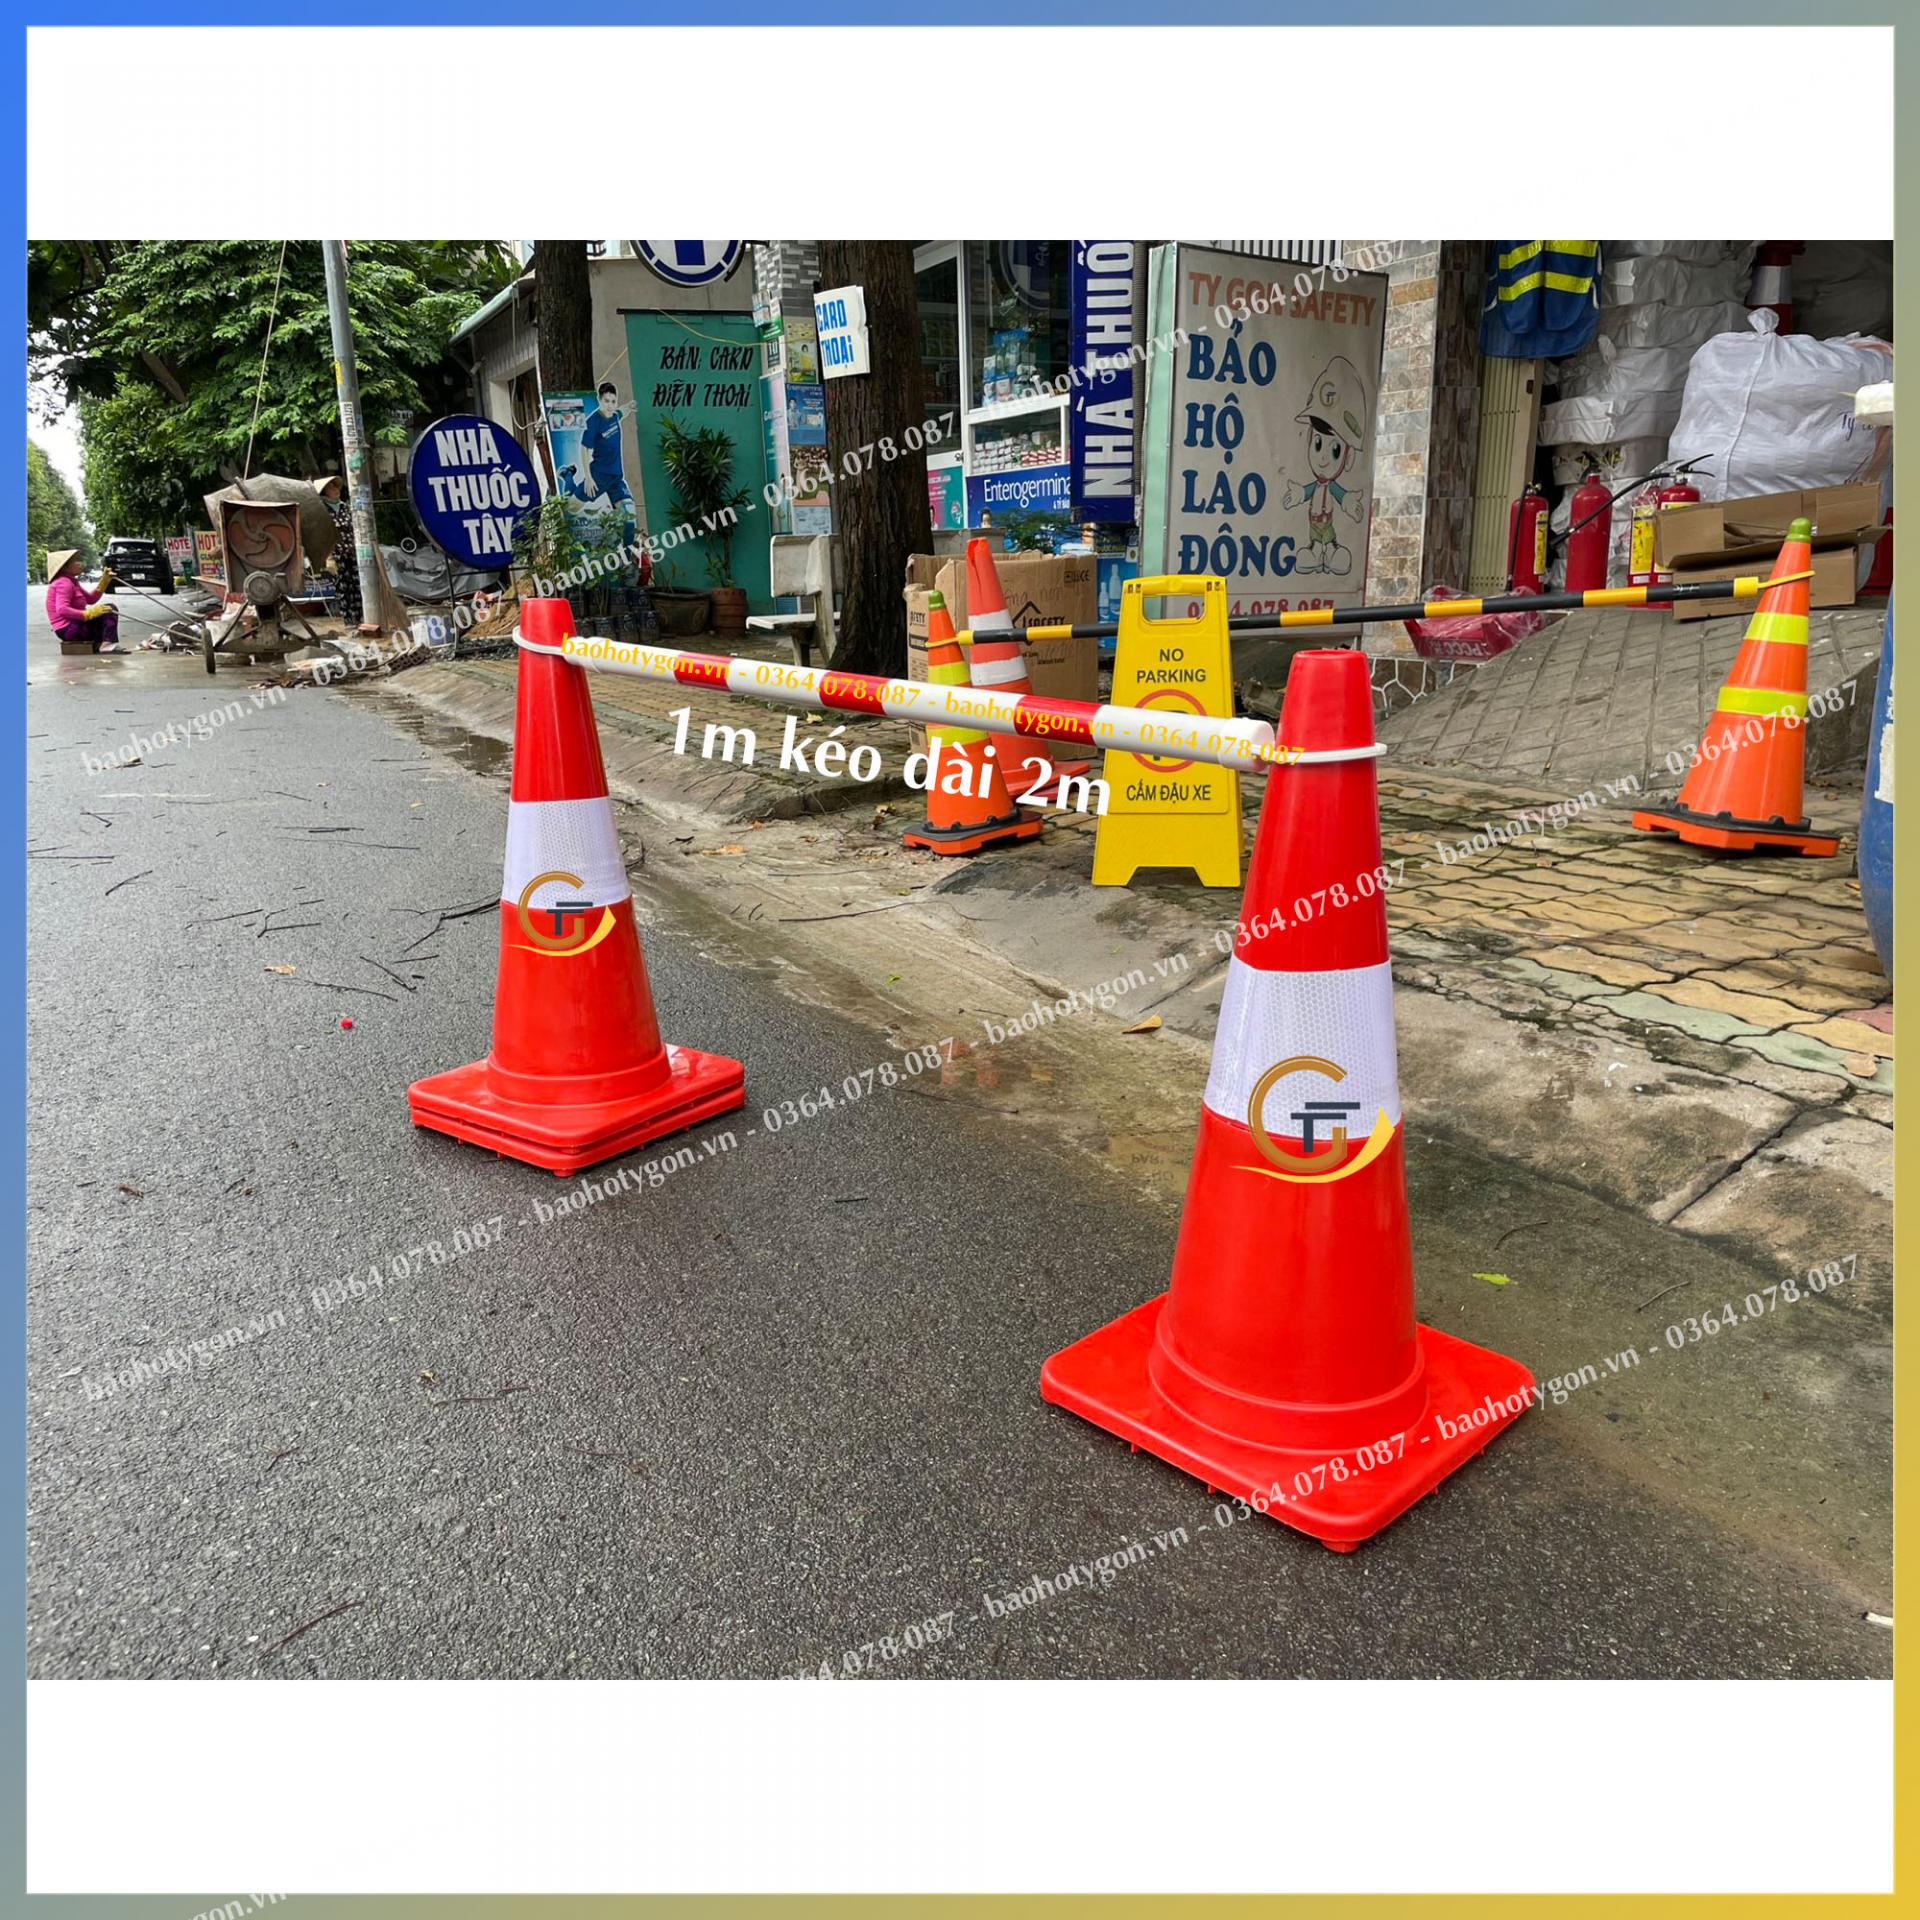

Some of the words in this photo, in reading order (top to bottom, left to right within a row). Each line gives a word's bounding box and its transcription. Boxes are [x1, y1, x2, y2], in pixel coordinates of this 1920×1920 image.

[816, 299, 848, 332] CARD
[1188, 271, 1222, 307] TY
[1226, 277, 1285, 316] GON
[1290, 289, 1377, 327] SAFETY
[710, 346, 754, 370] CARD
[1186, 318, 1277, 387] BẢO
[434, 423, 502, 467] NHÀ
[1076, 397, 1134, 498] NHÀ
[1183, 392, 1245, 465] HỘ
[428, 464, 530, 512] THUỐC
[983, 472, 1071, 508] Enterogermina
[1181, 469, 1267, 516] LAO
[463, 513, 514, 555] TÂY
[1178, 522, 1297, 577] ĐÔNG
[1188, 598, 1335, 618] 04.078087
[1136, 668, 1207, 683] PARKING
[1158, 648, 1184, 662] NO
[1126, 778, 1157, 801] CẤM
[1160, 782, 1189, 804] ĐẬU
[1192, 784, 1211, 800] XE
